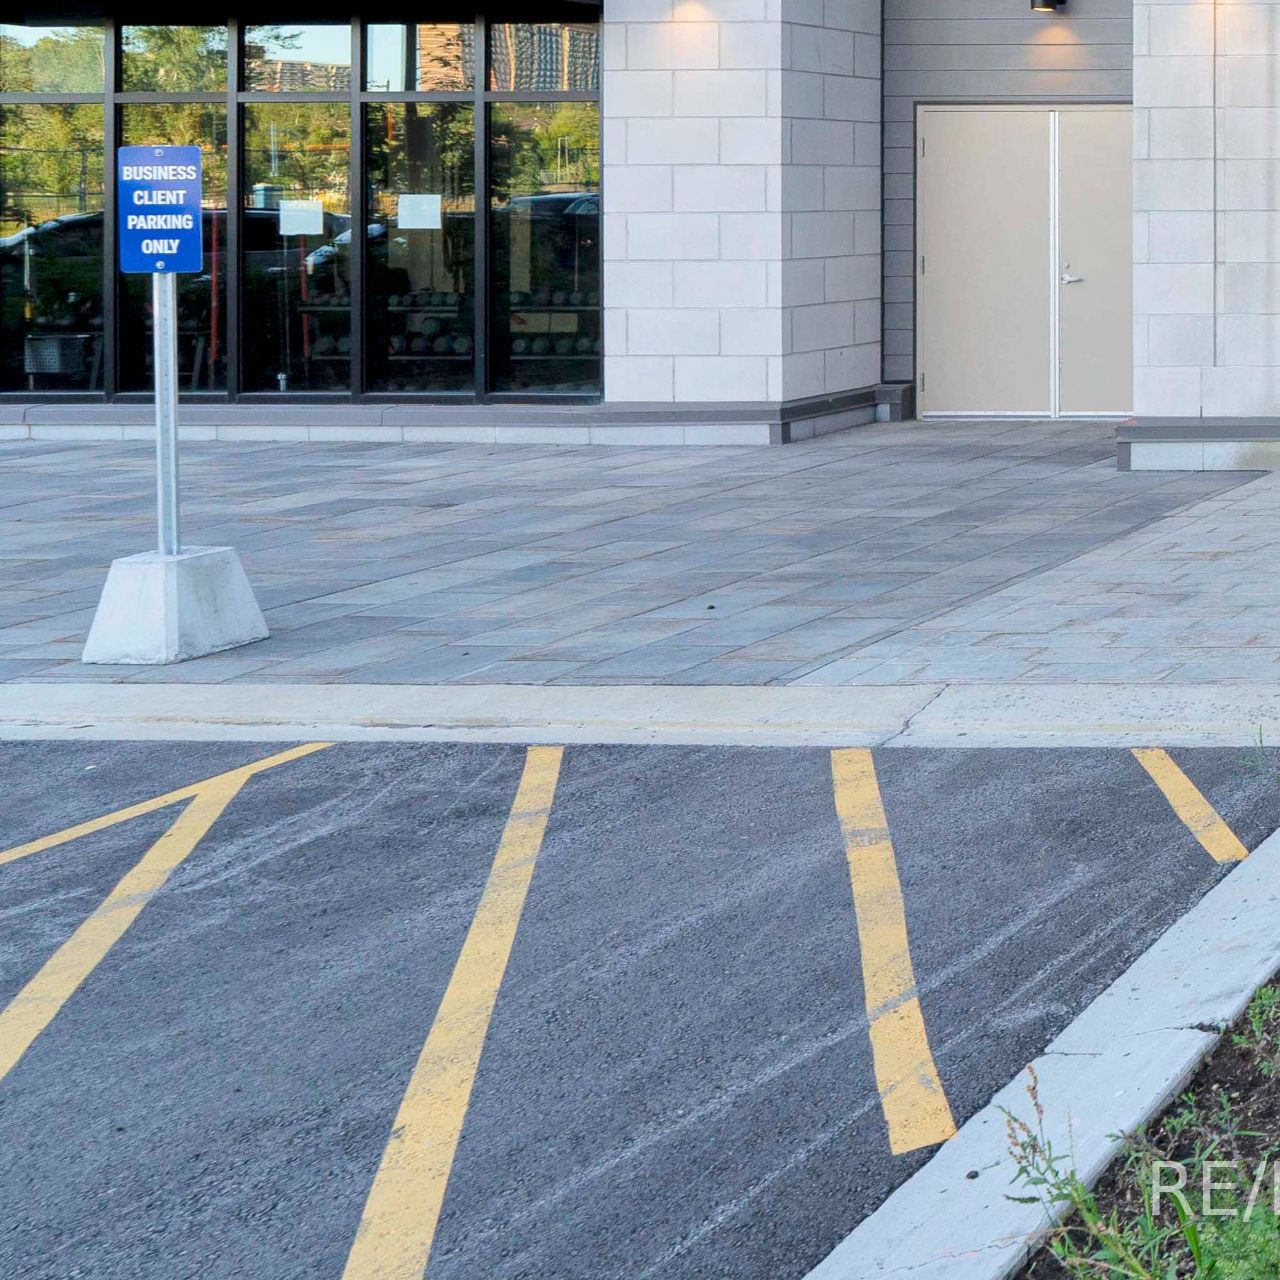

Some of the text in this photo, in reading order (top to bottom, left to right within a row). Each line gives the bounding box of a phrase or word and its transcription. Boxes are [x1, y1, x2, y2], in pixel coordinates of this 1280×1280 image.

[122, 165, 197, 181] BUSINESS
[133, 189, 187, 205] CLIENT
[127, 214, 194, 230] PARKING
[141, 239, 180, 254] ONLY
